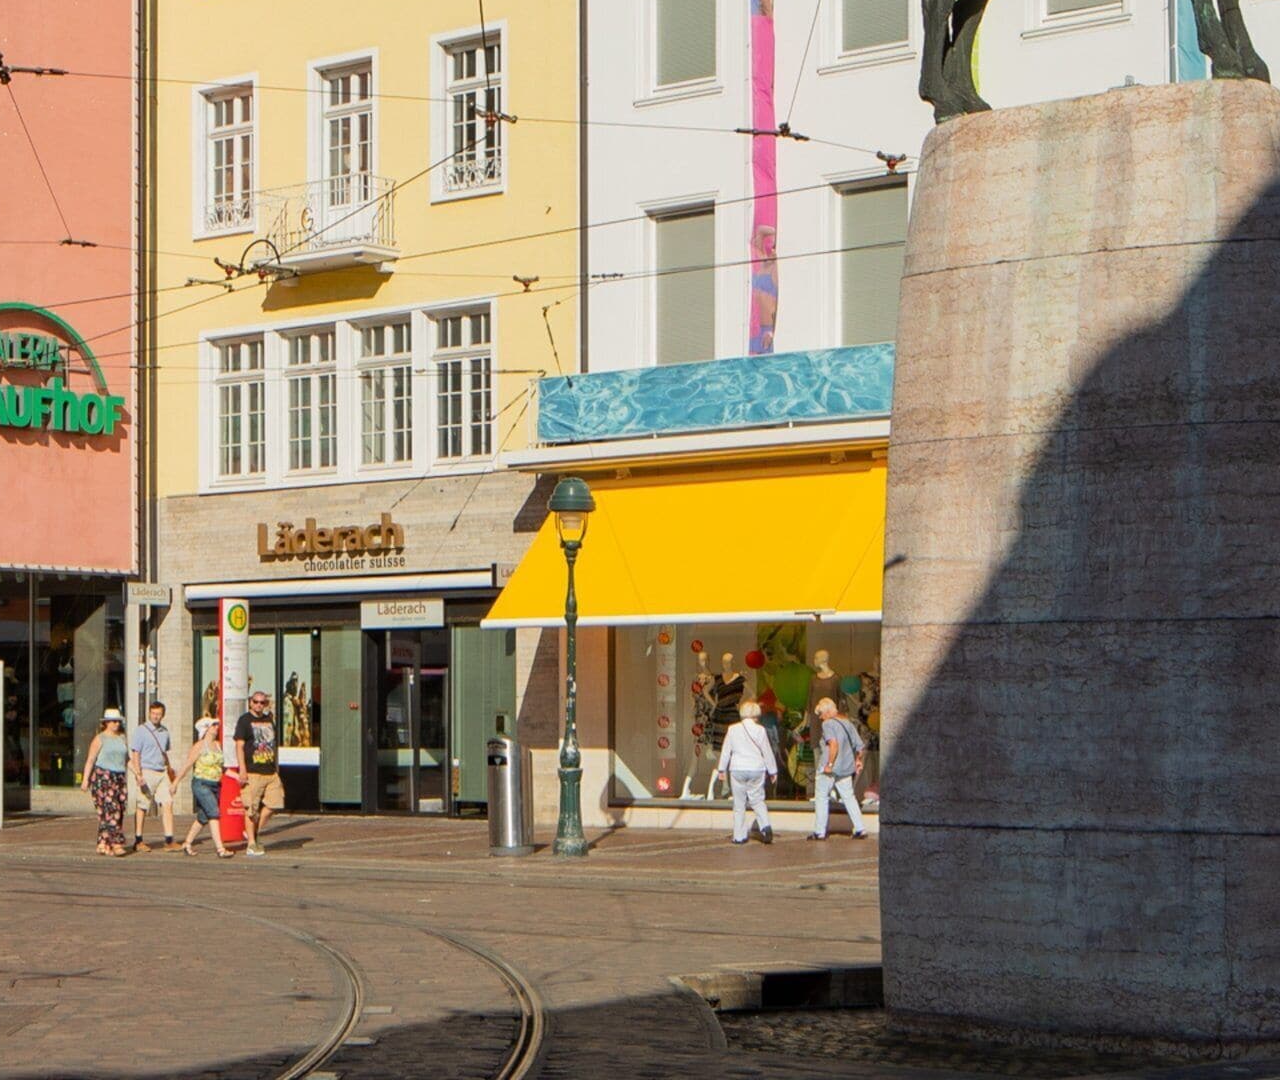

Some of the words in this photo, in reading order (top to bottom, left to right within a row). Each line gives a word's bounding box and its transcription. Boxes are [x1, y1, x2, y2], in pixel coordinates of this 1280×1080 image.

[257, 512, 405, 556] Läderach
[304, 557, 367, 572] chocolatier
[369, 555, 406, 569] suisse
[377, 601, 426, 616] Läderach
